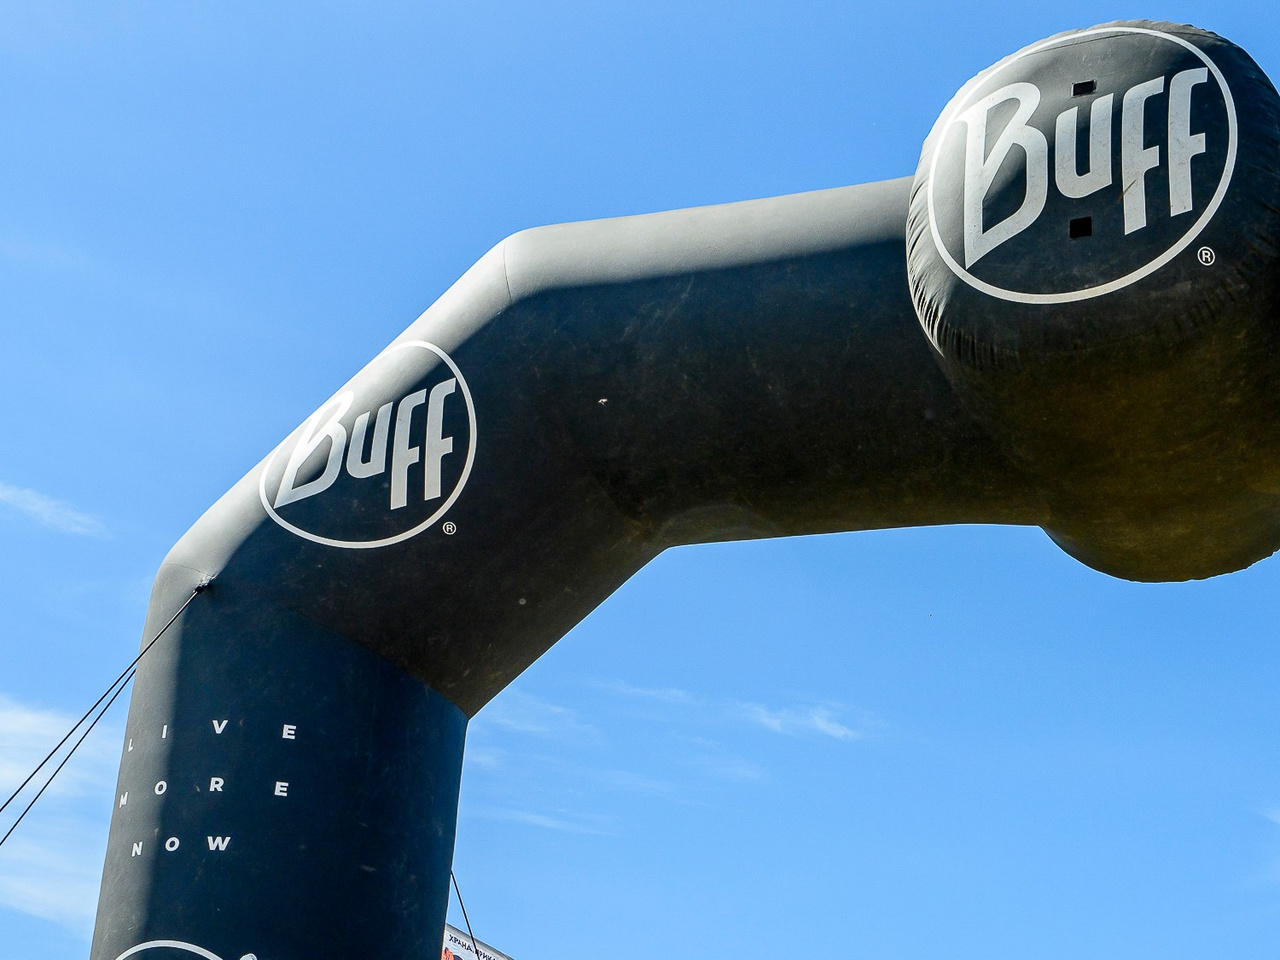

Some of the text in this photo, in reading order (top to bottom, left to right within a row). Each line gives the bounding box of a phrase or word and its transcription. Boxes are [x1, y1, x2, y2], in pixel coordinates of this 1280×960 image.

[128, 719, 297, 752] LIVE
[119, 777, 289, 808] MORE
[131, 836, 231, 857] NOW
